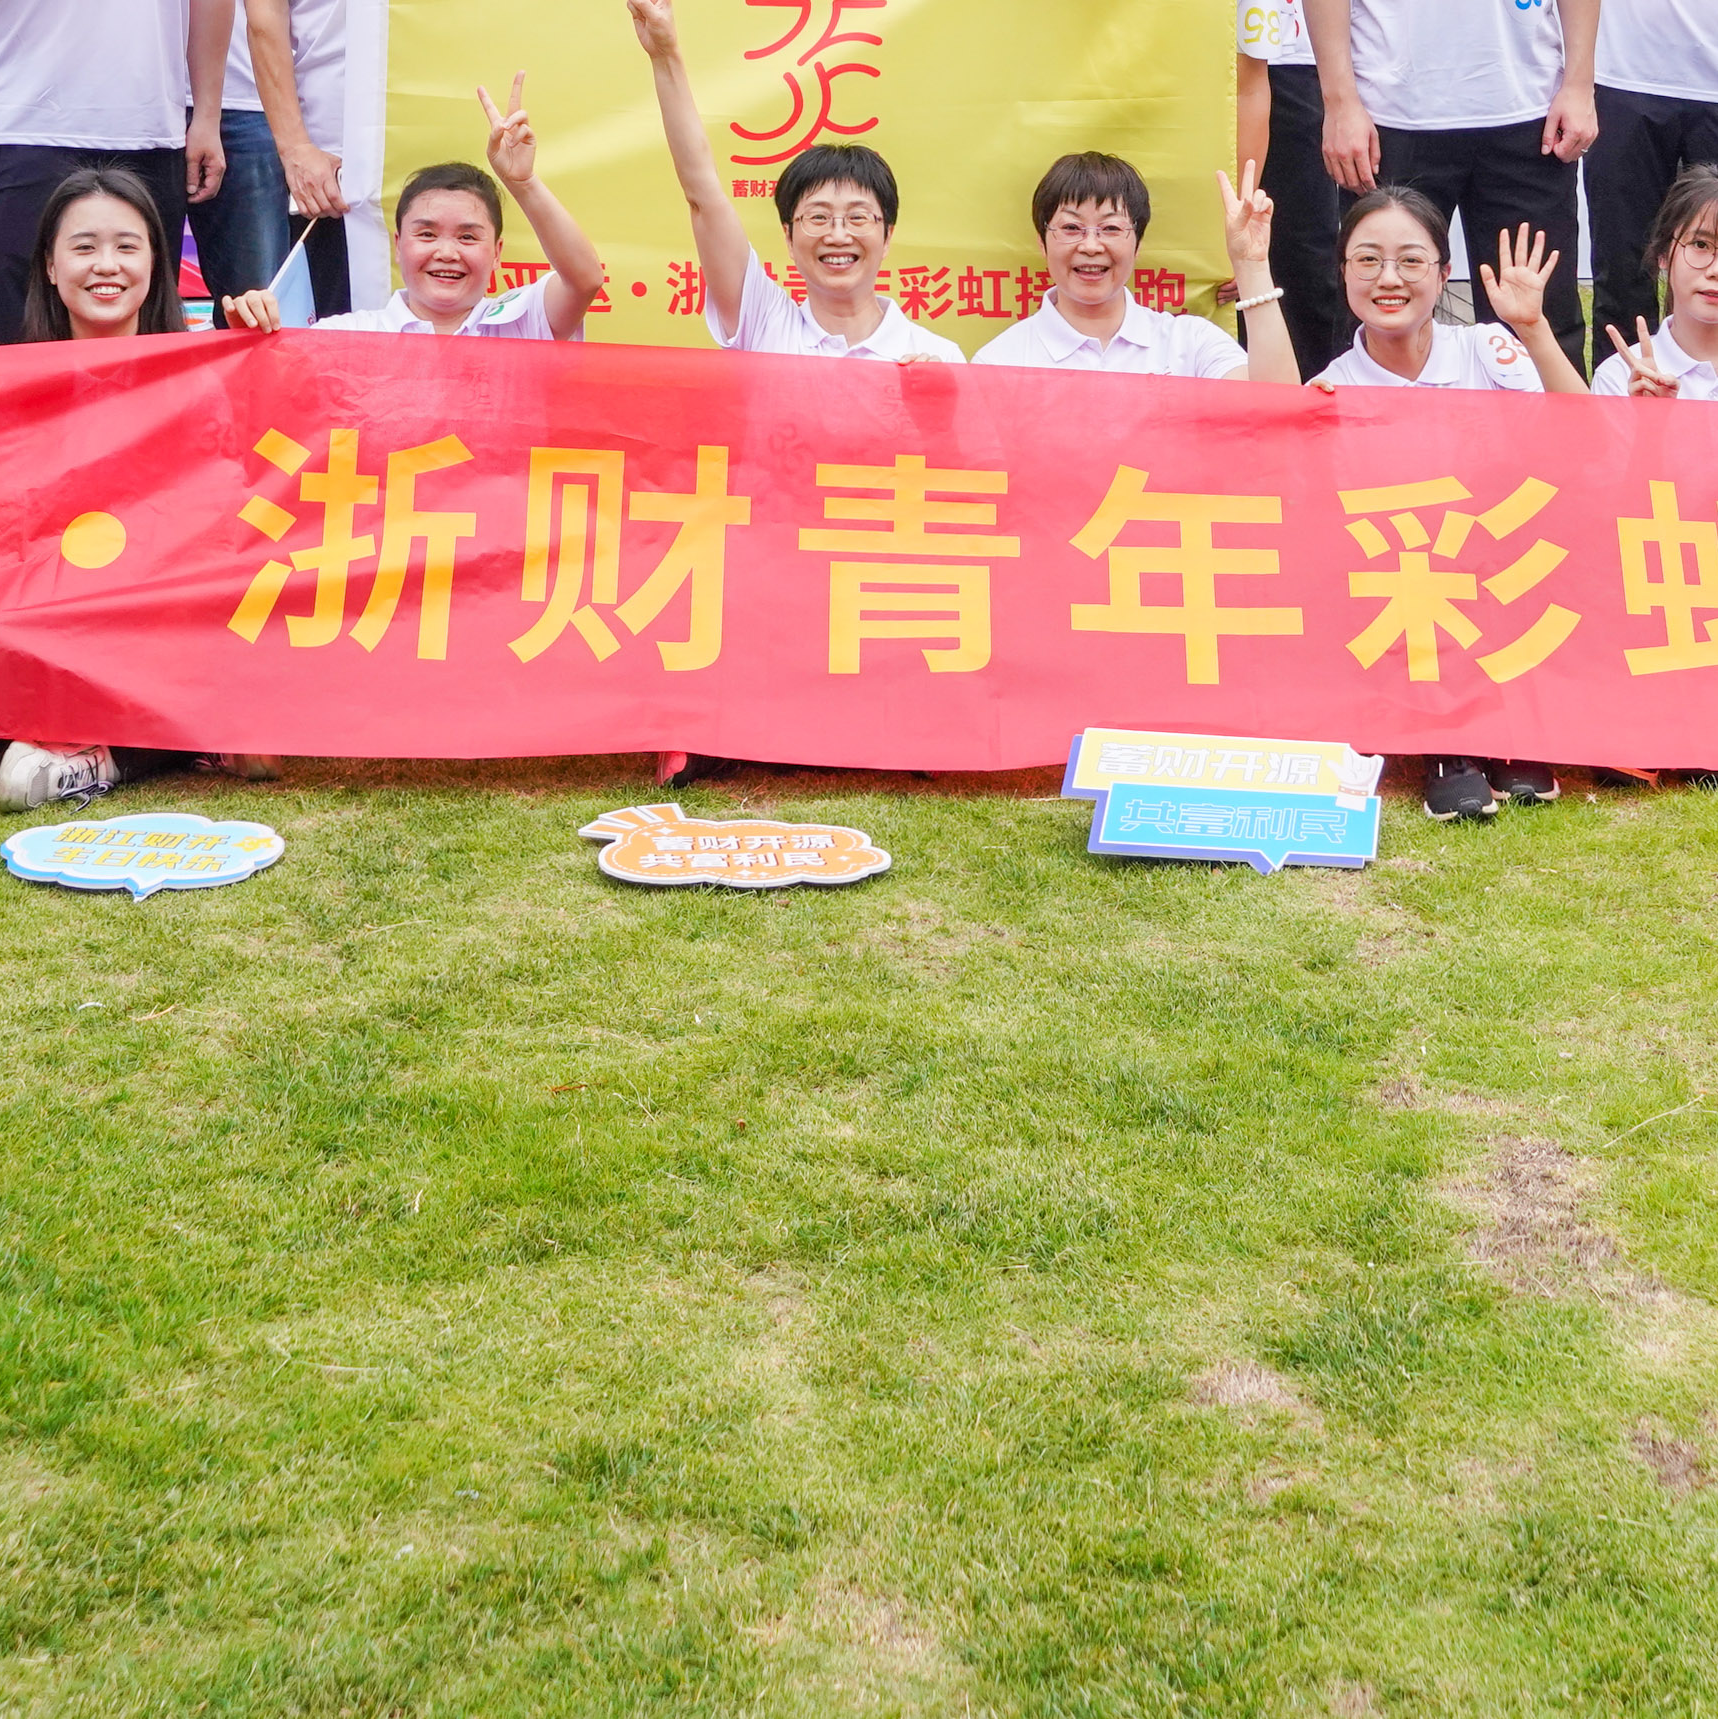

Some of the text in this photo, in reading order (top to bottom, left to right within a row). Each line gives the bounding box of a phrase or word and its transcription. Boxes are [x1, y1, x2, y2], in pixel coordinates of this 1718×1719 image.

[1096, 741, 1323, 786] 蓄财开源
[1119, 798, 1349, 844] 共富利民
[52, 825, 230, 852] 浙江财开
[653, 833, 839, 851] 蓄财开源
[43, 846, 232, 873] 生日快乐
[638, 852, 829, 869] 共富利民
